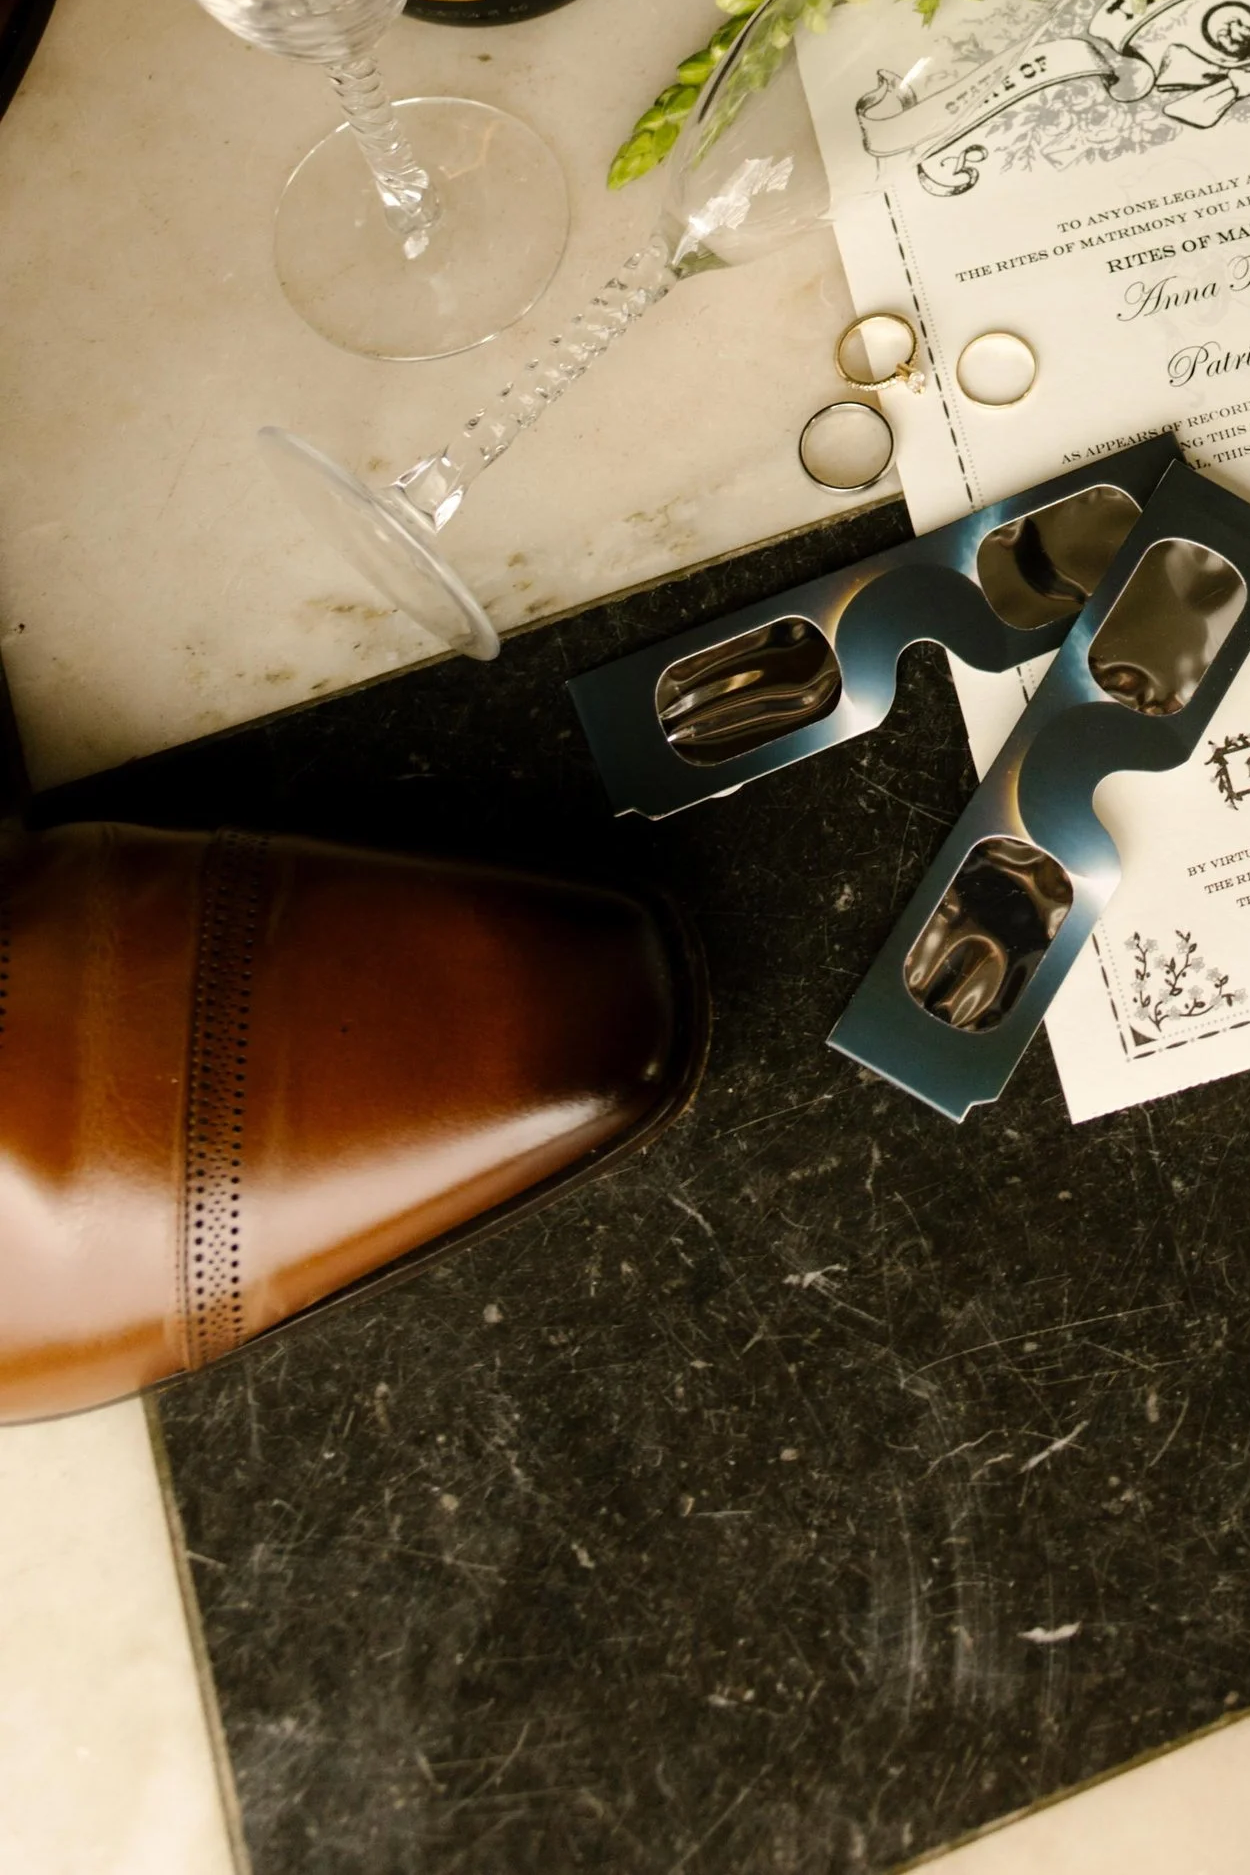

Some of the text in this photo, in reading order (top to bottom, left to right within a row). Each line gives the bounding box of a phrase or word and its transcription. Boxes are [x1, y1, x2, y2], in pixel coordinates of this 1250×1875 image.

[1019, 55, 1046, 79] OF
[1057, 219, 1081, 232] TO
[1088, 199, 1158, 225] ANYONE
[1162, 178, 1238, 205] LEGALLY
[955, 265, 991, 281] THE
[995, 250, 1048, 271] RITES
[1052, 242, 1074, 255] OF
[1079, 212, 1186, 248] MATRIMONY
[1193, 201, 1228, 218] YOU
[1106, 245, 1176, 273] RITES
[1181, 234, 1210, 252] OF
[1117, 276, 1220, 321] Anna
[1062, 453, 1084, 465] AS
[1085, 427, 1165, 458] APPEARS
[1161, 420, 1183, 433] OF
[1206, 425, 1246, 442] THIS
[1187, 863, 1205, 876] BY
[1204, 878, 1233, 893] THE
